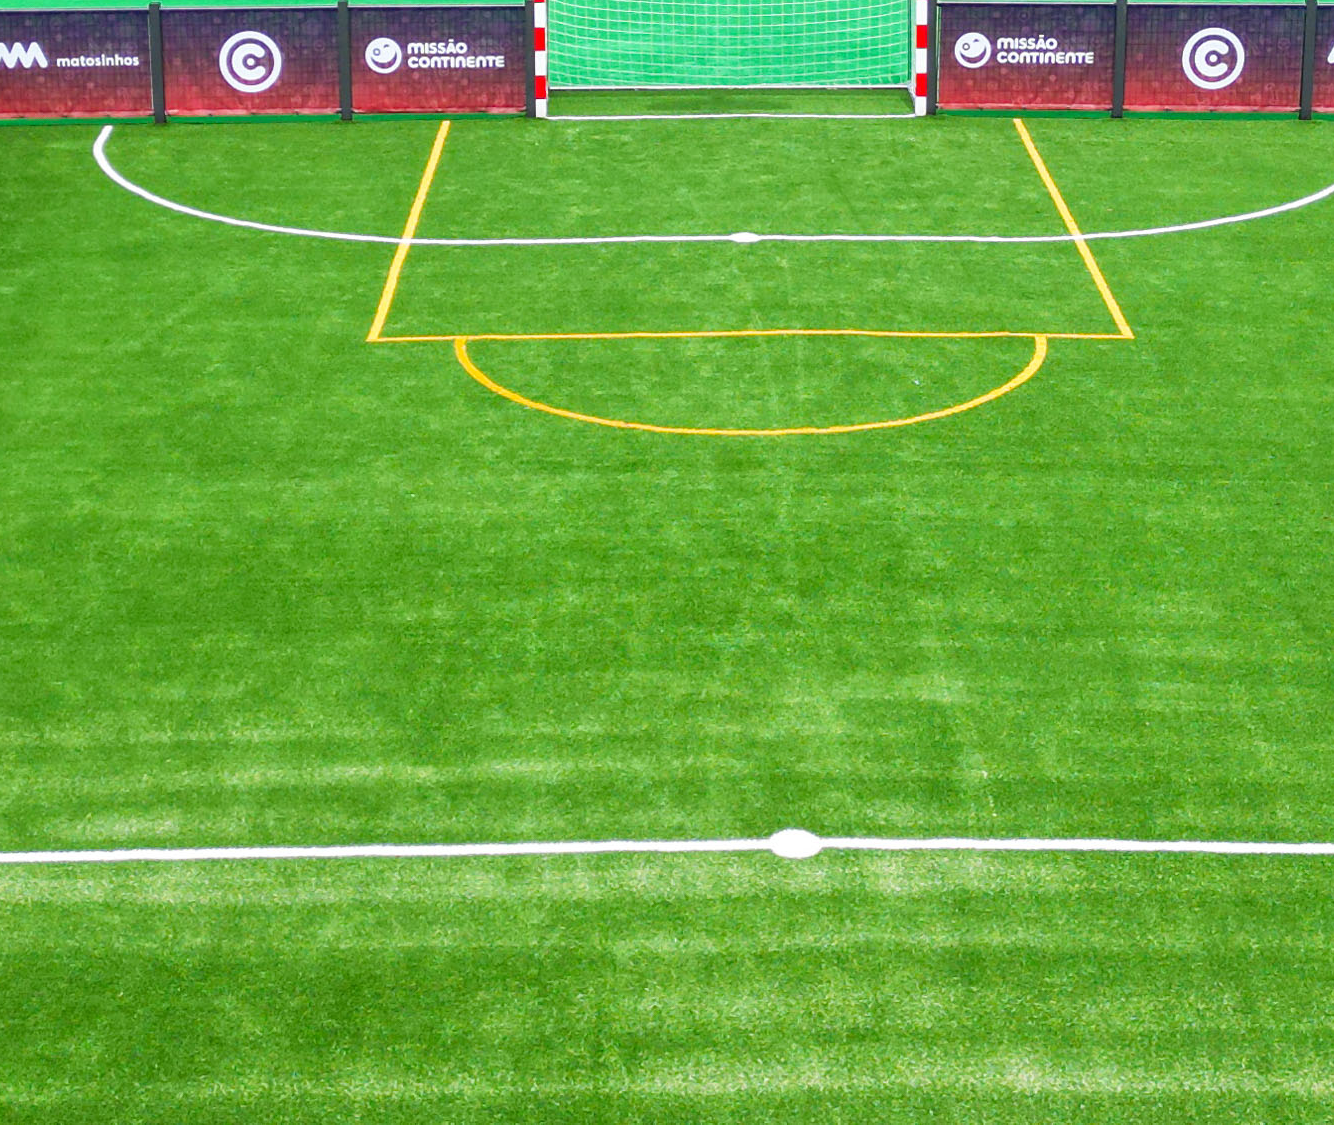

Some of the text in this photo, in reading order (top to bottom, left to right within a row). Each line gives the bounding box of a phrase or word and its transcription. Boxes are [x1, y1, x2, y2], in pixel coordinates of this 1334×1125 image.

[407, 38, 468, 54] MISSÃO
[996, 34, 1058, 50] MISSÃO
[56, 53, 140, 68] matosinhos
[407, 55, 506, 68] CONTINENTE
[996, 51, 1095, 64] CONTINENTE
